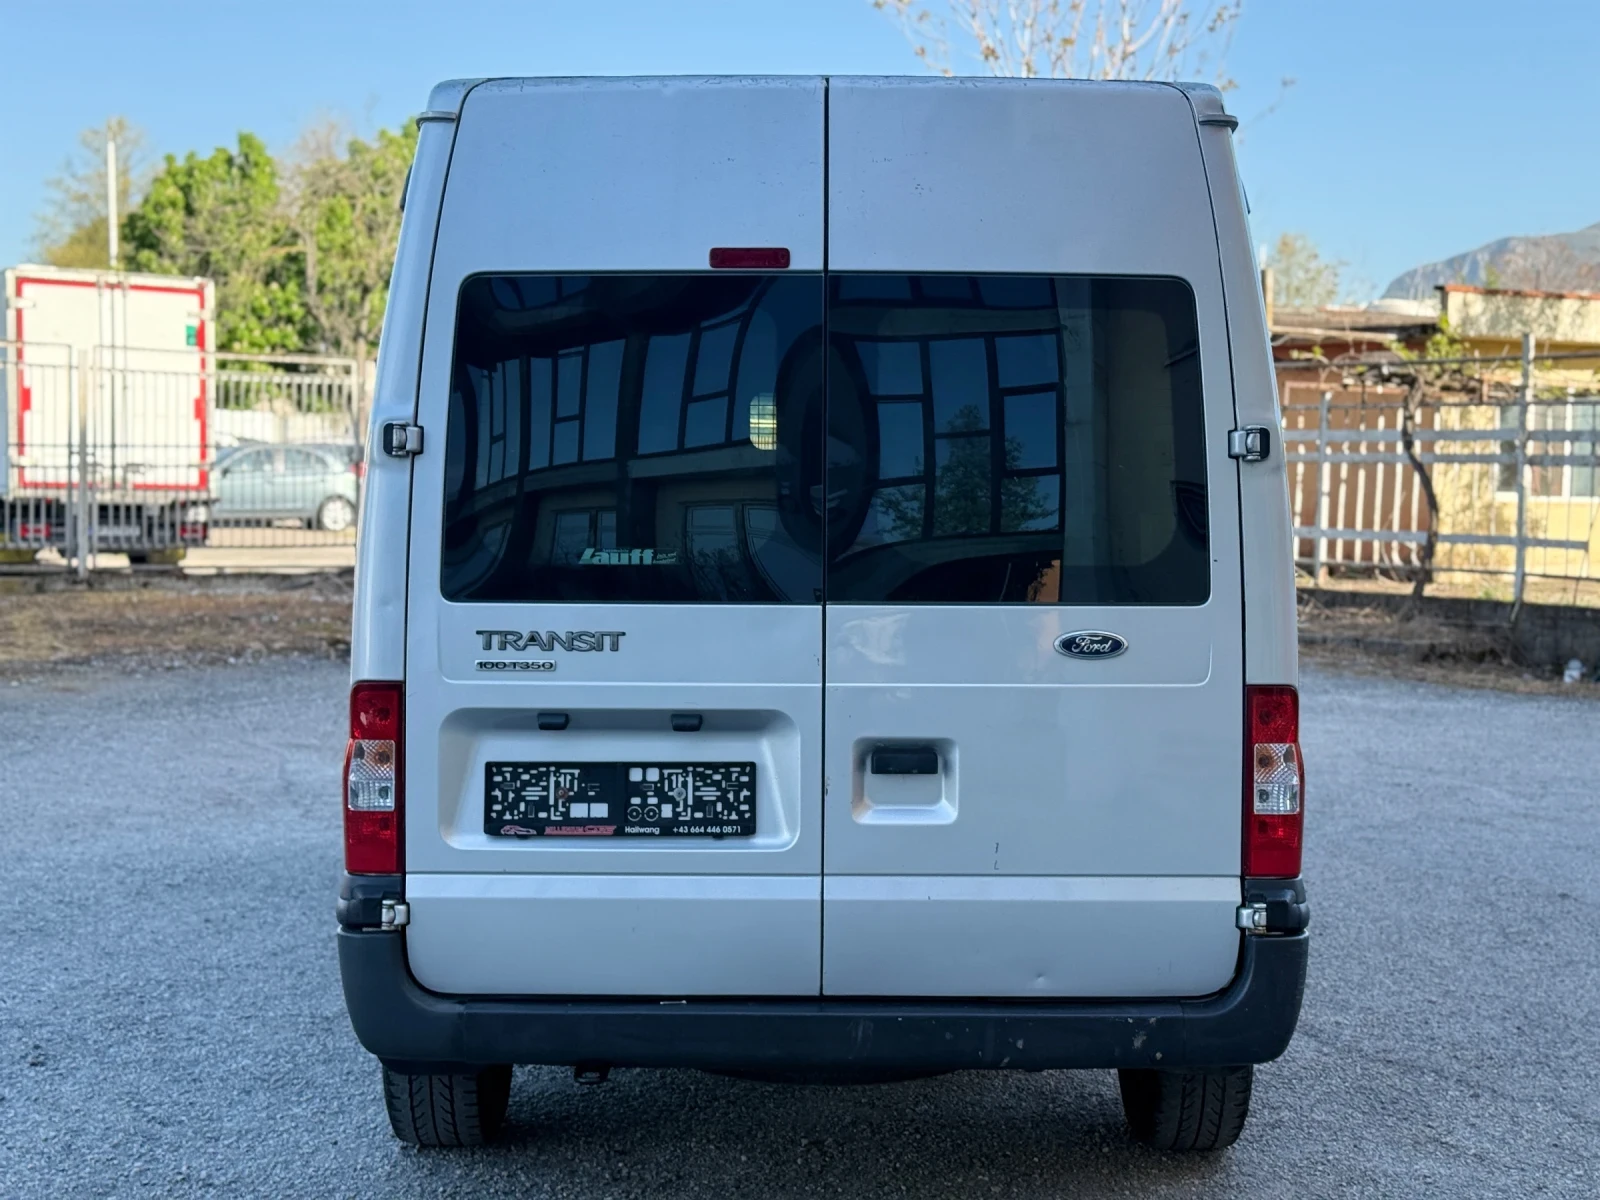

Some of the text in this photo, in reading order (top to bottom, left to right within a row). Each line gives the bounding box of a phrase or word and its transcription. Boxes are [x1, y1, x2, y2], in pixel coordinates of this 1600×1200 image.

[476, 630, 626, 652] TRANSIT
[1071, 636, 1112, 653] Ford
[672, 826, 741, 834] +43 664 446 0571
